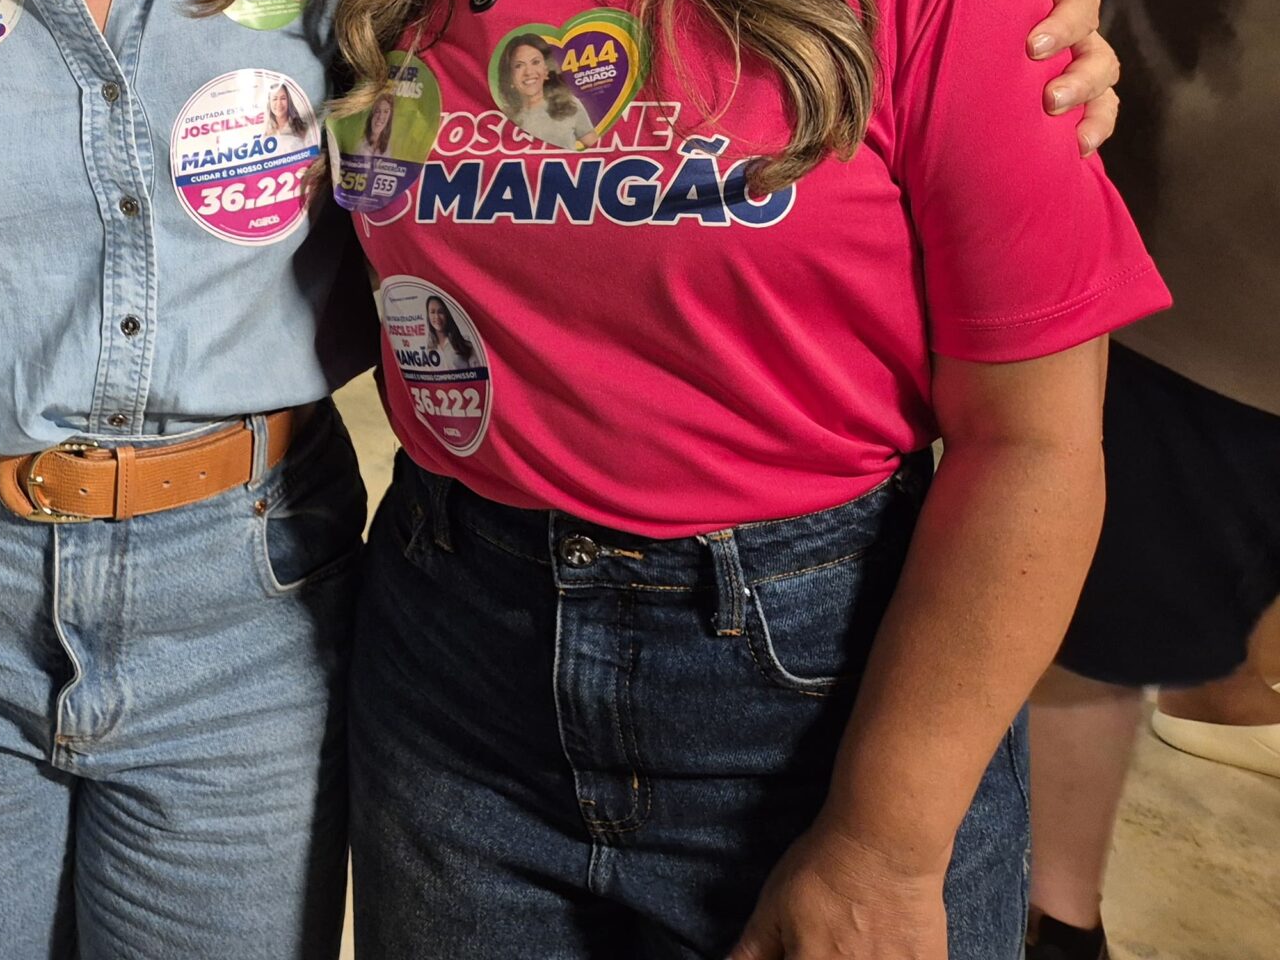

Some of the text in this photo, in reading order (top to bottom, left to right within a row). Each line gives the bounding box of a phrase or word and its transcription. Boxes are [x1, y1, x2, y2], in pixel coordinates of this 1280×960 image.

[561, 39, 618, 73] 444
[575, 69, 617, 86] CAIADO
[185, 109, 224, 124] DEPUTADA
[181, 134, 278, 172] MANGÃO
[190, 150, 311, 183] CUIDAR É O NOSSO COMPROMISSO!
[374, 178, 396, 192] 555
[416, 134, 796, 228] MANGÃO
[410, 387, 482, 418] 36.222
